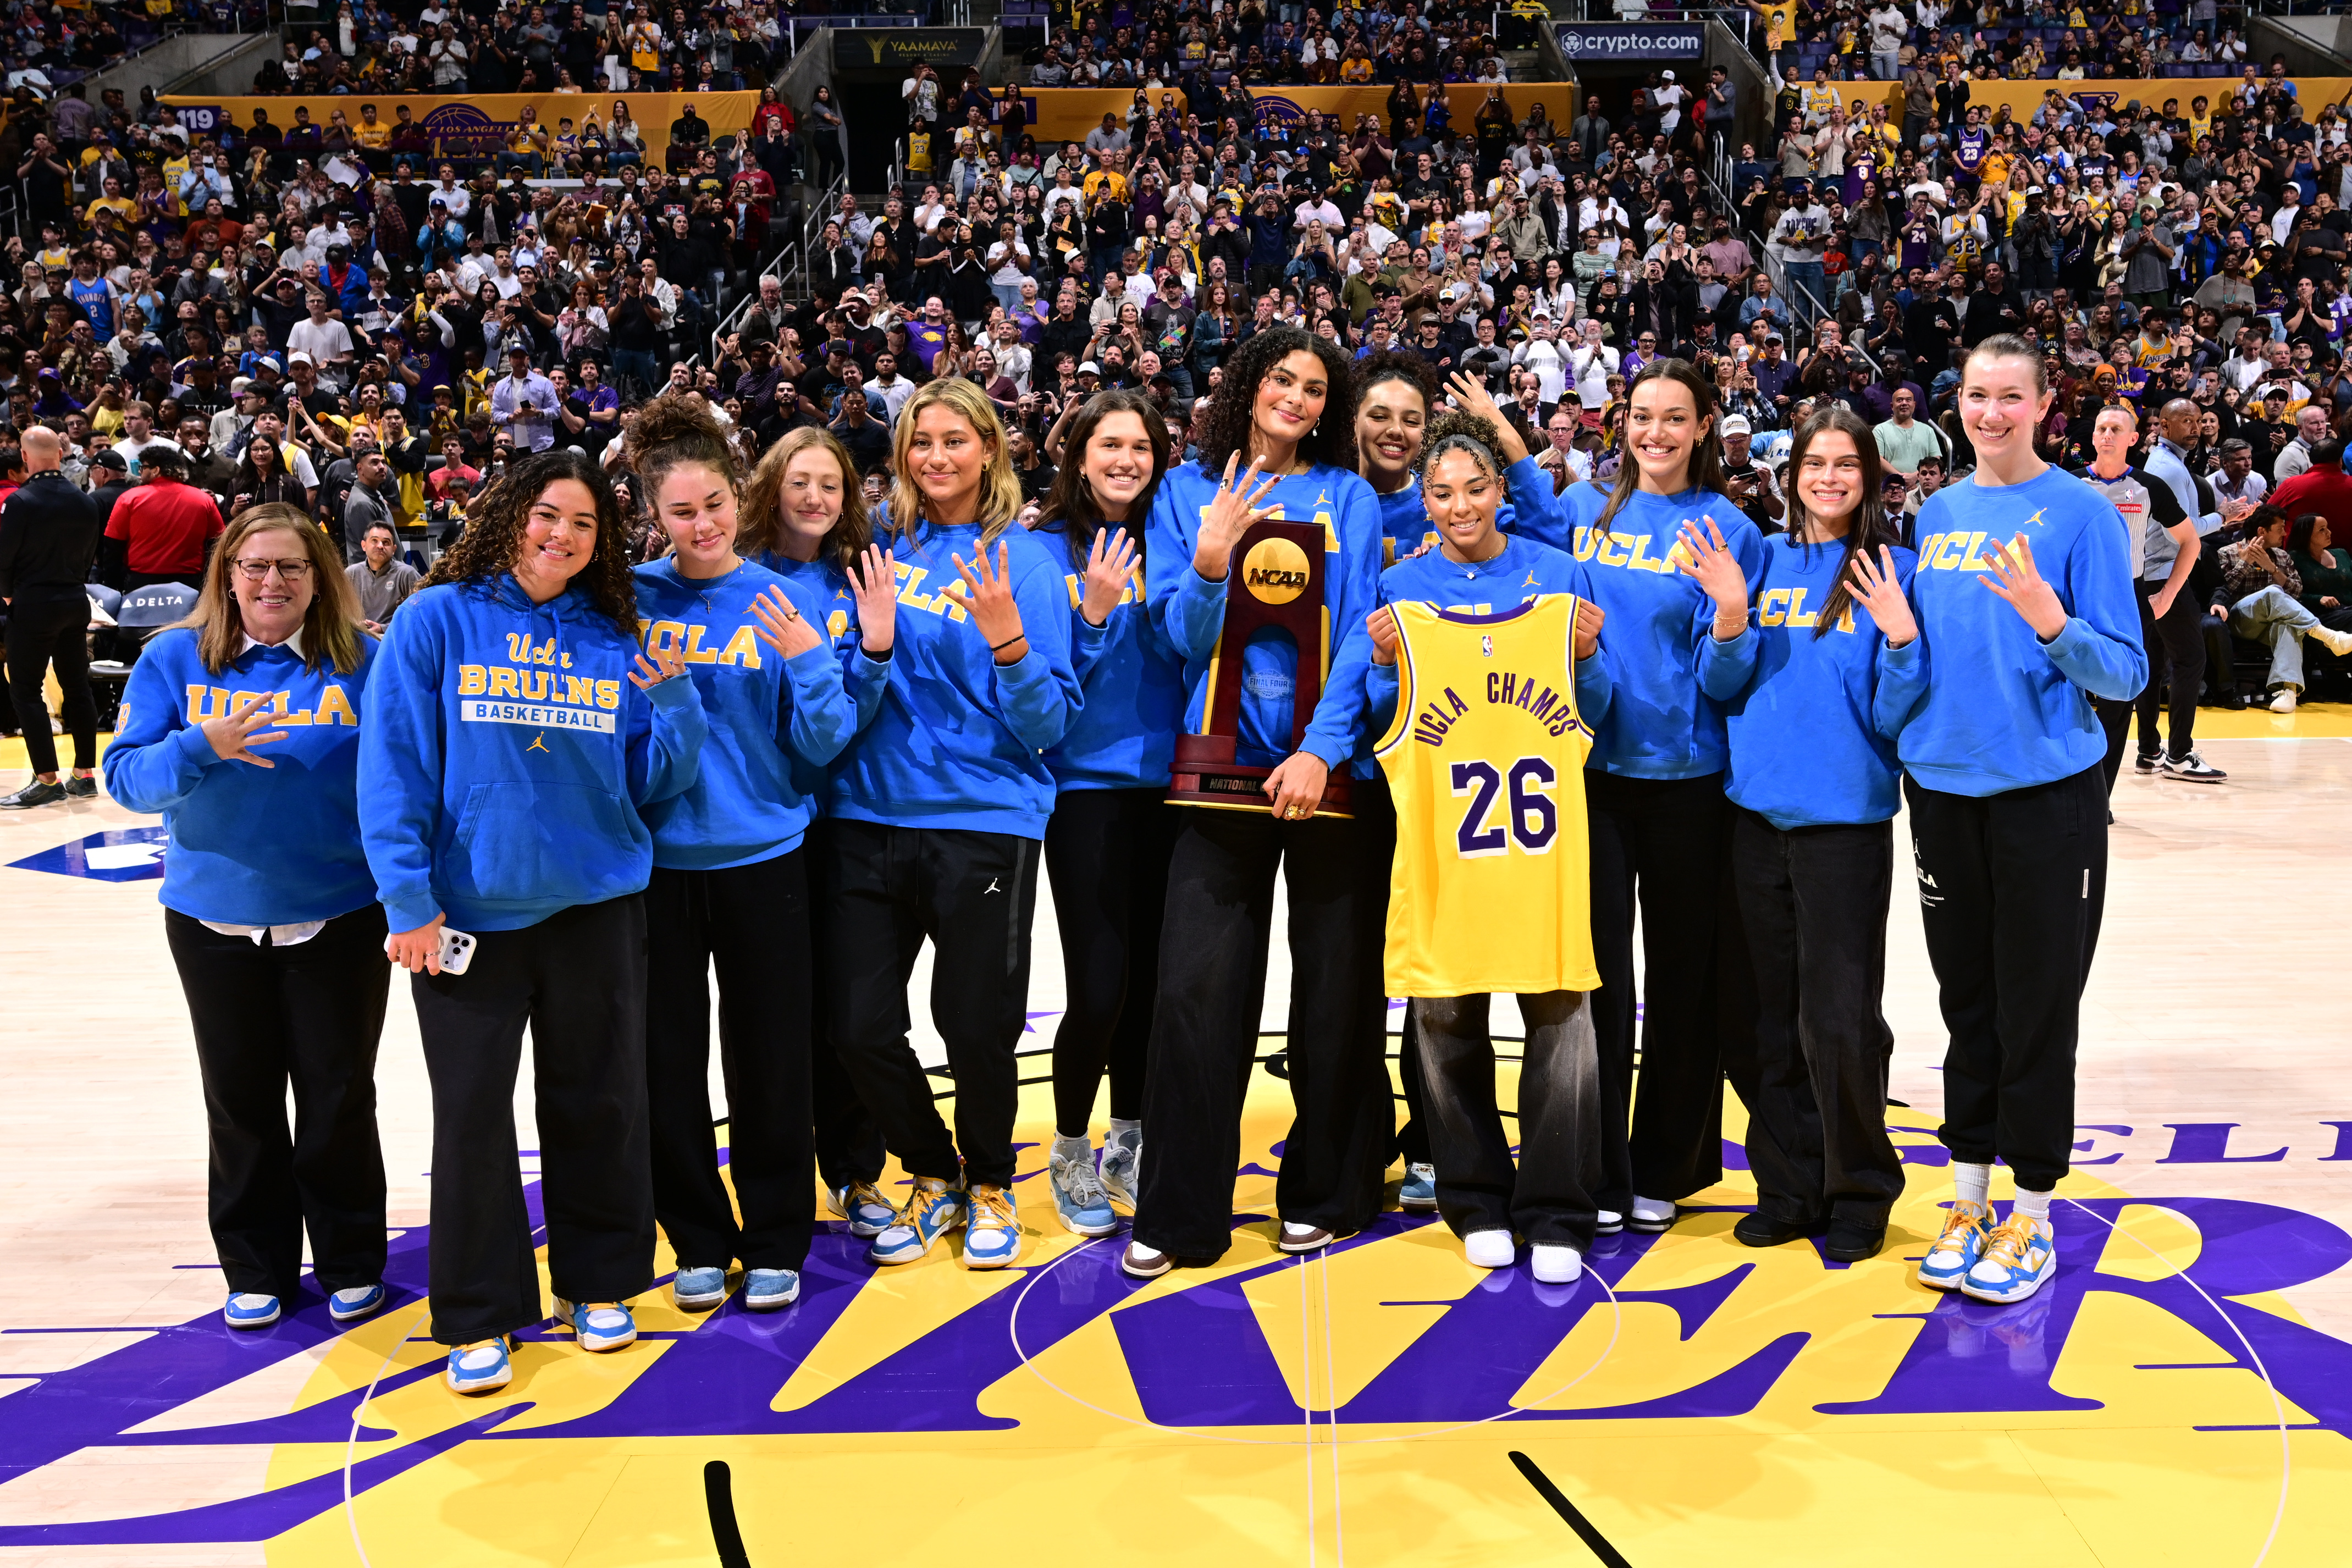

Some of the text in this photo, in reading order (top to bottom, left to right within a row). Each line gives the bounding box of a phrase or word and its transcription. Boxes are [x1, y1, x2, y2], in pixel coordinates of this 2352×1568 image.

[1585, 34, 1699, 52] crypto.com
[1786, 98, 1795, 110] 8
[176, 109, 214, 129] 119
[915, 145, 925, 154] 23
[1961, 141, 1981, 149] LAKERS
[1963, 148, 1979, 161] 23
[1858, 166, 1869, 180] 8
[2083, 167, 2104, 176] OKC
[168, 174, 180, 186] 23
[624, 233, 638, 246] 23
[1911, 230, 1928, 244] 24
[1954, 236, 1977, 255] 32
[76, 292, 106, 305] THUNDER
[90, 305, 98, 318] 2
[1573, 527, 1696, 576] UCLA
[1917, 531, 2030, 573] UCLA
[1247, 567, 1307, 589] NCAA
[137, 595, 183, 607] DELTA
[893, 565, 973, 625] CLA
[1759, 588, 1860, 634] CLA
[506, 632, 572, 669] Ucla
[458, 665, 619, 710] BRUINS
[1249, 678, 1288, 688] FINAL FOUR
[475, 703, 603, 729] BASKETBALL
[1415, 672, 1577, 747] UCLA CHAMPS
[1210, 778, 1258, 793] NATIONAL
[1448, 755, 1559, 860] 26
